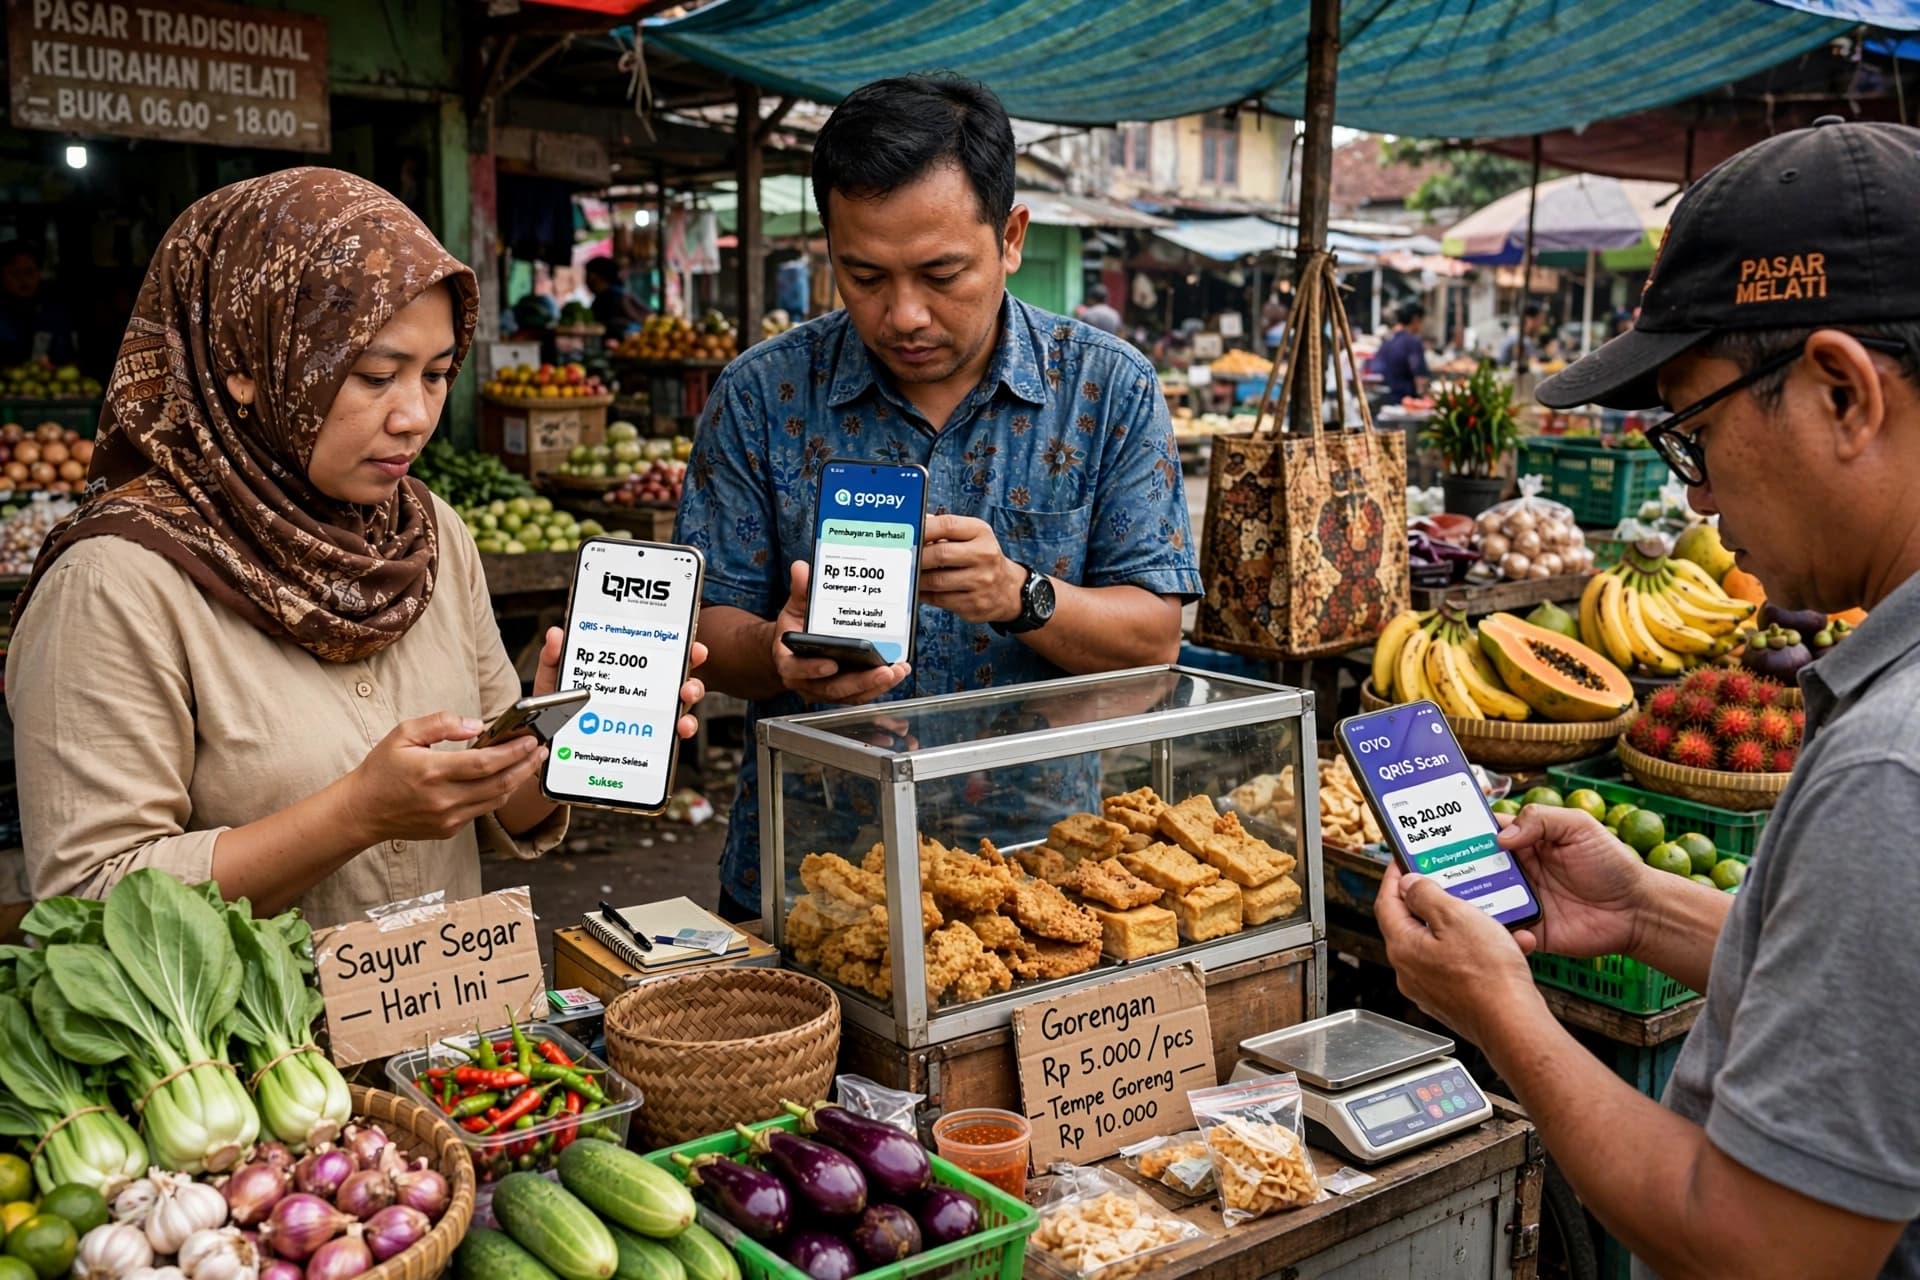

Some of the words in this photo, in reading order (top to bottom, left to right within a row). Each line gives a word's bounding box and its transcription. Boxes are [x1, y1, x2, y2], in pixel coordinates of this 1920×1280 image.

[33, 0, 128, 39] PASAR
[136, 8, 310, 61] TRADISIONAL
[32, 41, 199, 89] KELURAHAN
[208, 60, 297, 100] MELATI
[57, 88, 132, 123] BUKA
[140, 98, 209, 128] 06.00
[234, 107, 296, 136] 18.00
[1741, 253, 1825, 282] PASAR
[1735, 276, 1827, 304] MELATI
[854, 492, 906, 509] gopay
[602, 571, 671, 602] QRIS
[824, 564, 840, 579] Rp
[843, 566, 885, 580] 15.000
[579, 621, 598, 631] QRIS
[605, 624, 652, 637] Pembayaran
[654, 630, 680, 642] Digital
[576, 648, 594, 664] Rp
[598, 651, 648, 669] 25.000
[602, 719, 654, 738] DANA
[1359, 736, 1391, 754] OVO
[588, 775, 624, 789] Sukses
[1379, 760, 1414, 781] QRIS
[1414, 754, 1450, 770] Scan
[1398, 815, 1418, 829] Rp
[1417, 801, 1462, 823] 20.000
[336, 939, 427, 983] Sayur
[440, 921, 521, 962] Segar
[381, 981, 441, 1023] Hari
[454, 971, 487, 1005] Ini
[1041, 996, 1156, 1040] Gorengan
[1042, 1057, 1070, 1088] Rp
[1080, 1038, 1141, 1074] 5.000
[1047, 1091, 1105, 1119] Tempe
[1112, 1070, 1173, 1099] Goreng
[1059, 1124, 1084, 1150] Rp
[1095, 1100, 1157, 1137] 10.000
